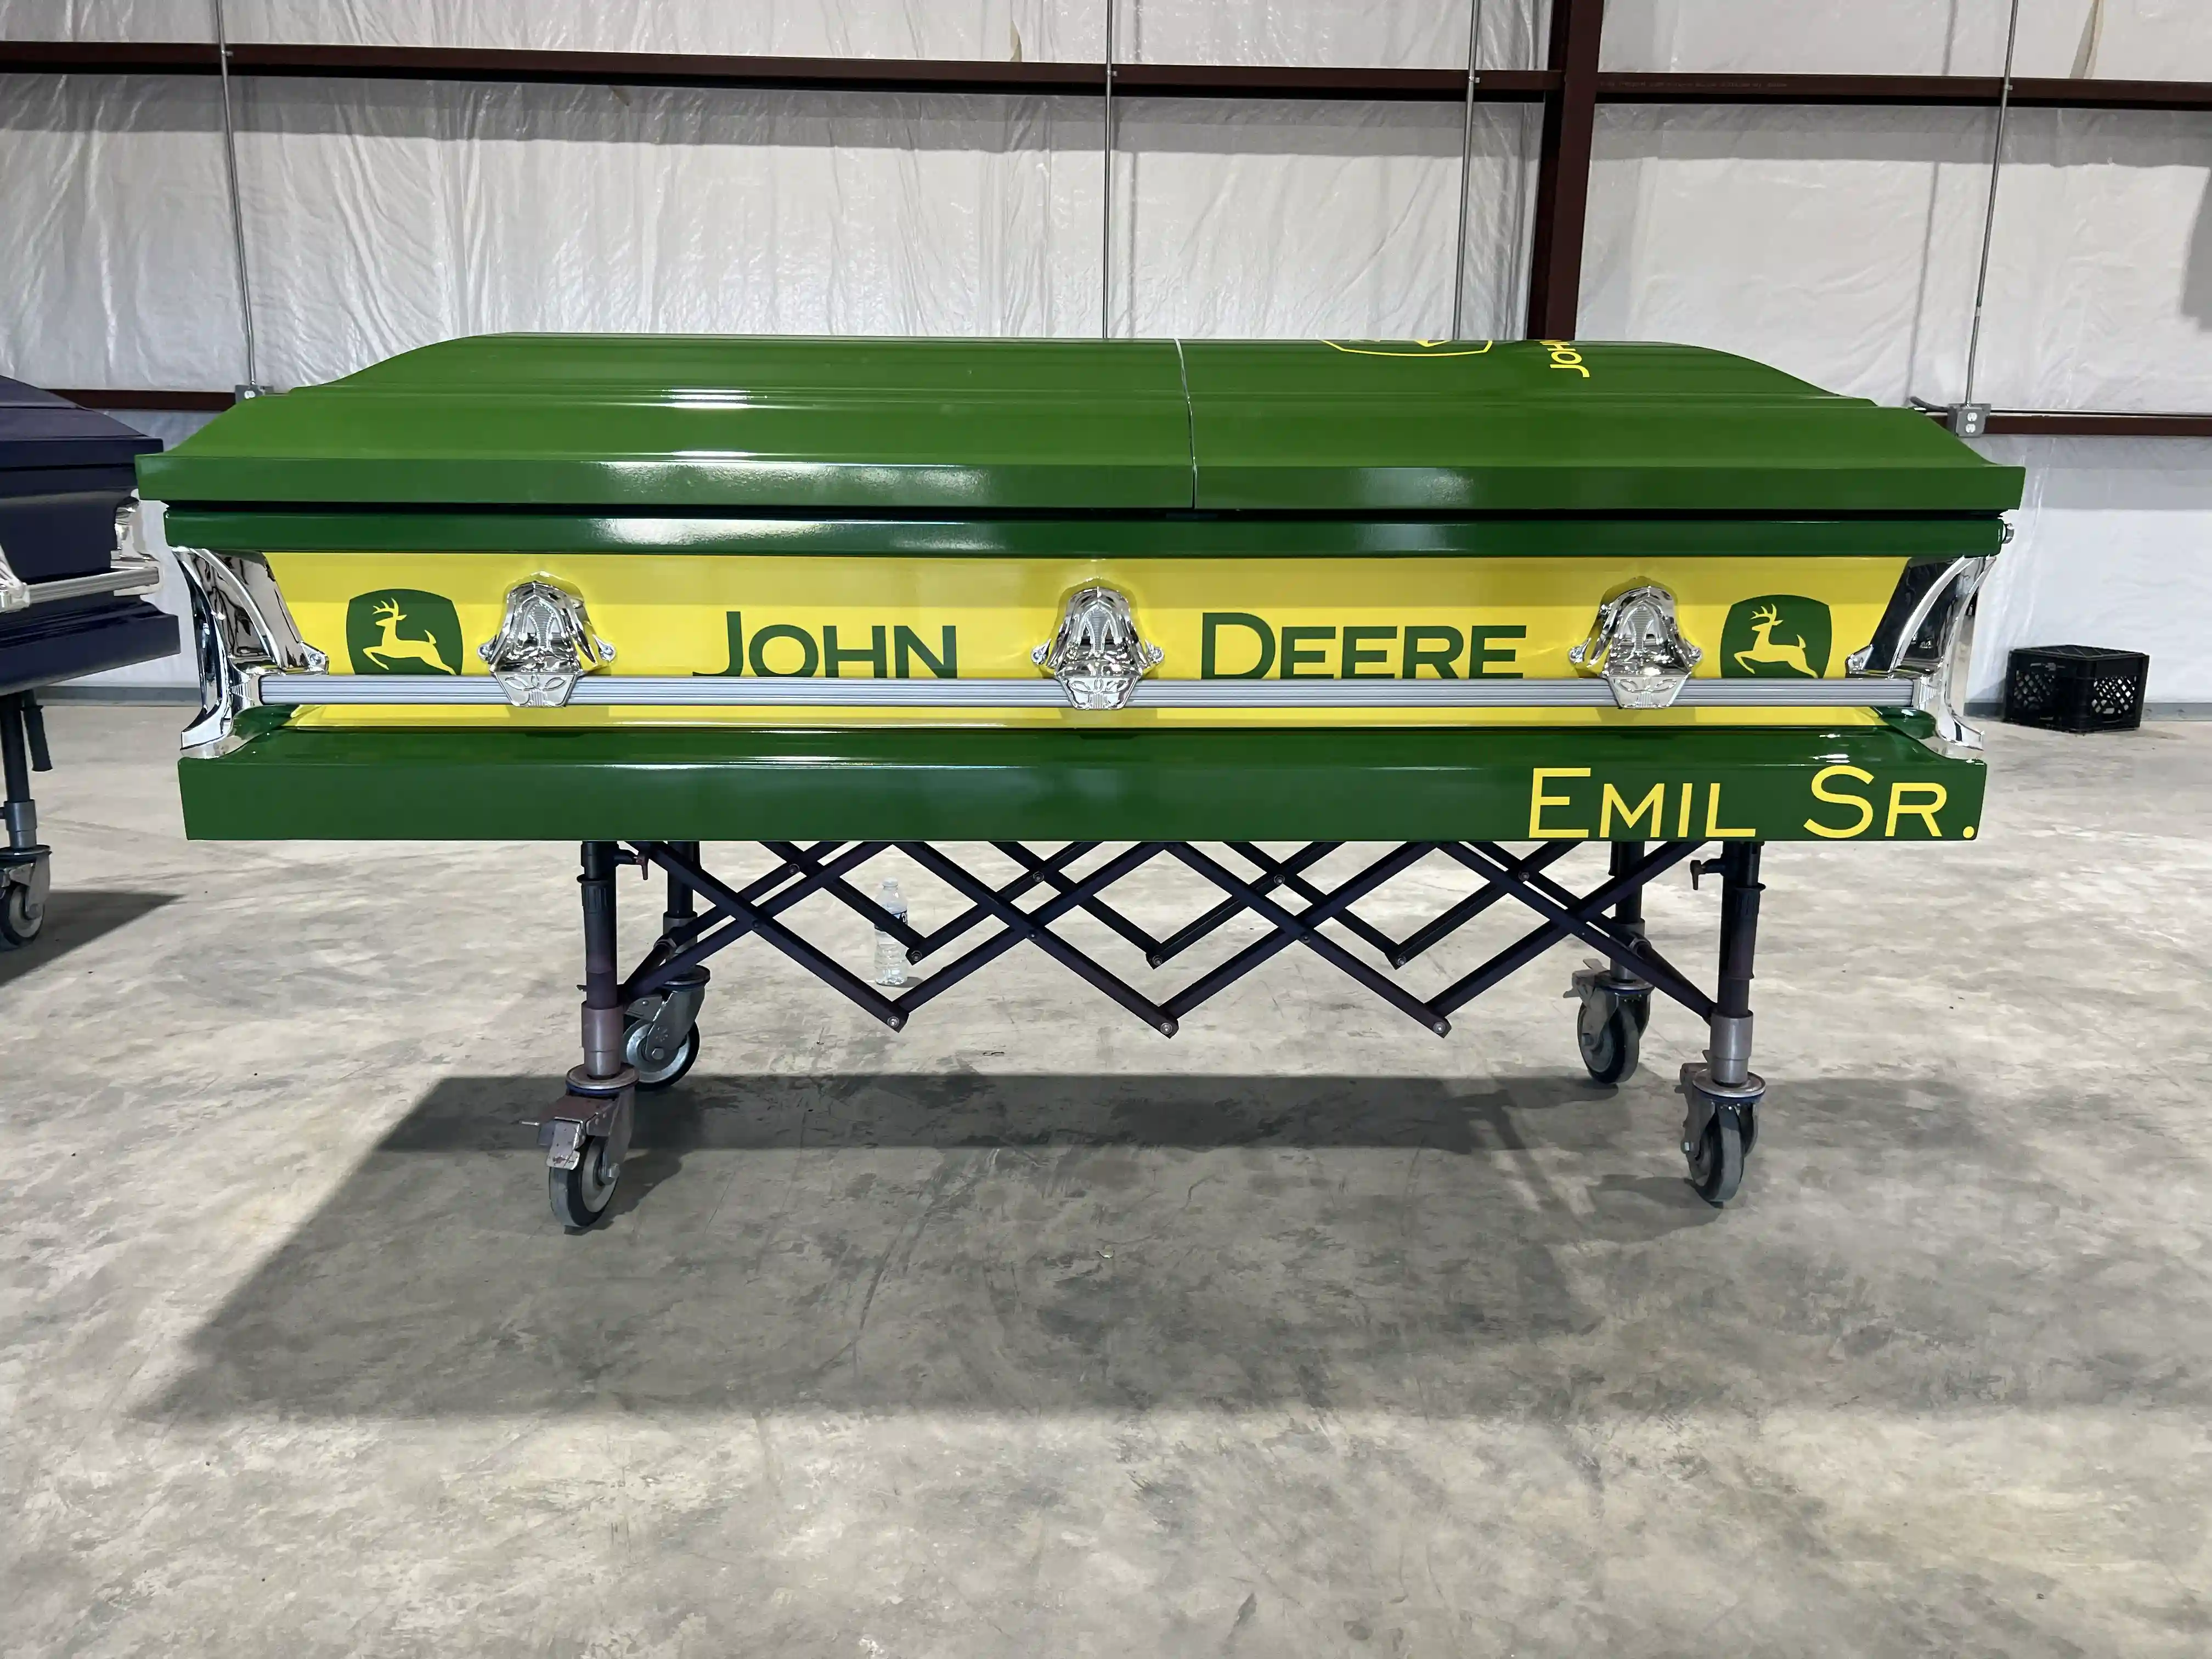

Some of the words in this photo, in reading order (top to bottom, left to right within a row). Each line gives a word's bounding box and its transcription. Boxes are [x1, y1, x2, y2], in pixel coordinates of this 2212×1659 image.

[692, 611, 958, 679] JOHN
[1201, 612, 1527, 680] DEERE
[1528, 768, 1756, 839] EMIL
[1803, 765, 1975, 839] SR.
